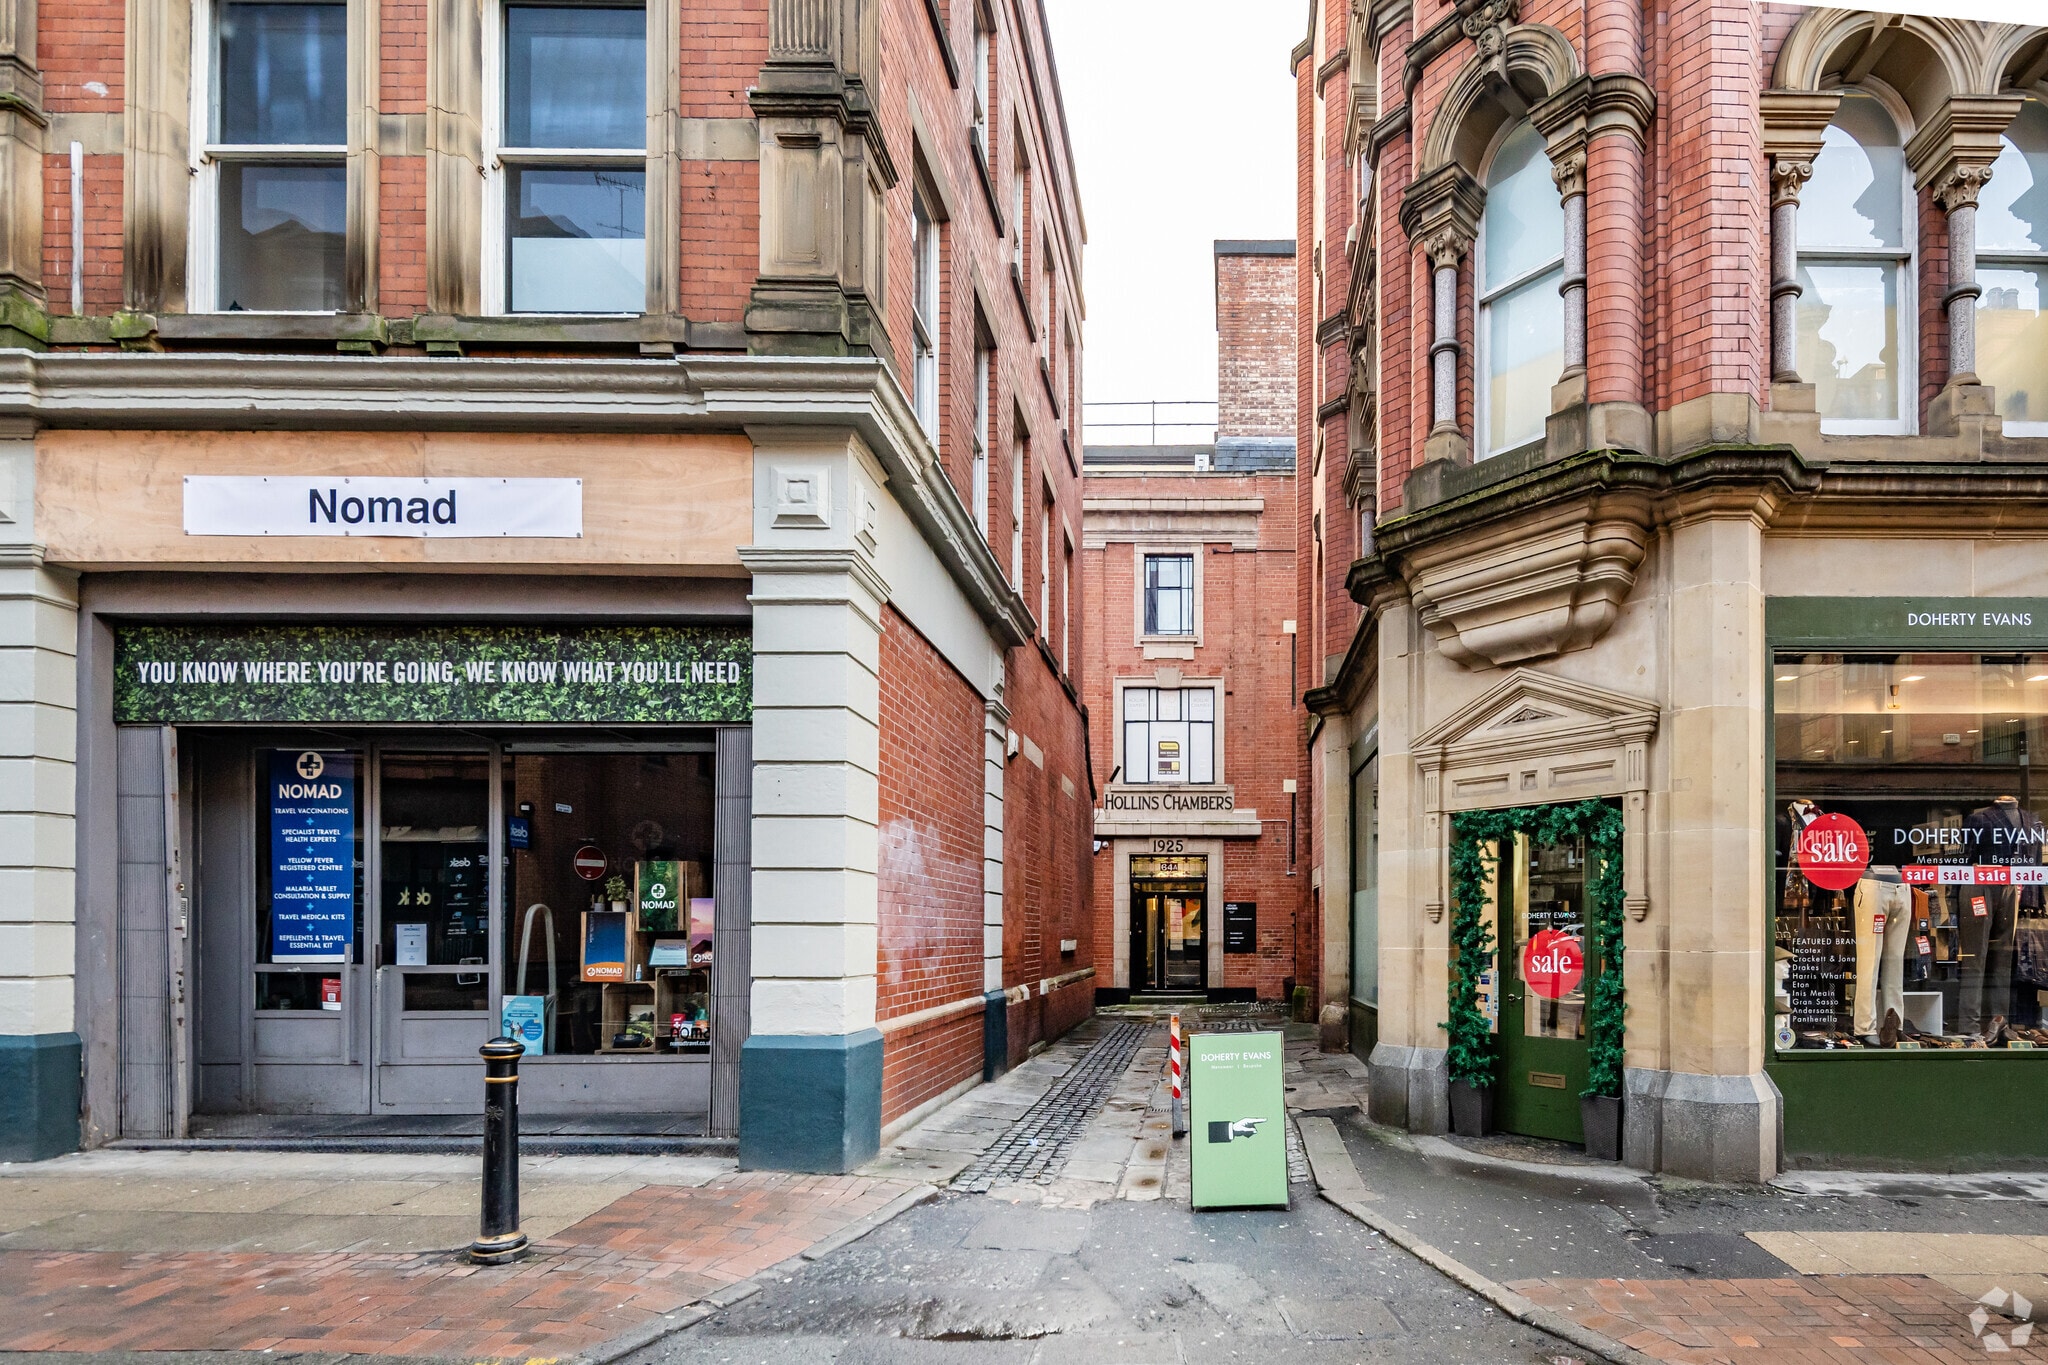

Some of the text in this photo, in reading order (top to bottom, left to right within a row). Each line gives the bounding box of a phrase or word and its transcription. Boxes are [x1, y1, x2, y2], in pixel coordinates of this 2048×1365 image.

[309, 488, 457, 524] Nomad
[1908, 612, 2032, 626] DOHERTY EVANS
[138, 661, 176, 684] YOU
[182, 661, 238, 684] KNOW
[243, 661, 312, 684] WHERE
[393, 661, 460, 686] GOING,
[465, 661, 496, 684] WE
[502, 661, 557, 684] KNOW
[562, 661, 615, 684] WHAT
[691, 661, 740, 684] NEED
[278, 784, 342, 799] NOMAD
[1105, 794, 1233, 810] HOLLINS CHAMBERS
[1894, 828, 2048, 845] DOHERTY EVAN
[1153, 839, 1184, 852] 1925
[1811, 834, 1858, 863] sale
[1916, 855, 2034, 866] Menswear Bespoke
[1906, 869, 1935, 880] sale
[1943, 870, 1970, 881] sale
[1978, 869, 2007, 882] sale
[2015, 870, 2043, 881] sale
[641, 900, 675, 910] NOMAD
[1553, 911, 1577, 919] EVANS
[1531, 948, 1572, 974] sale
[1201, 1051, 1272, 1061] DOHERTY EVANS
